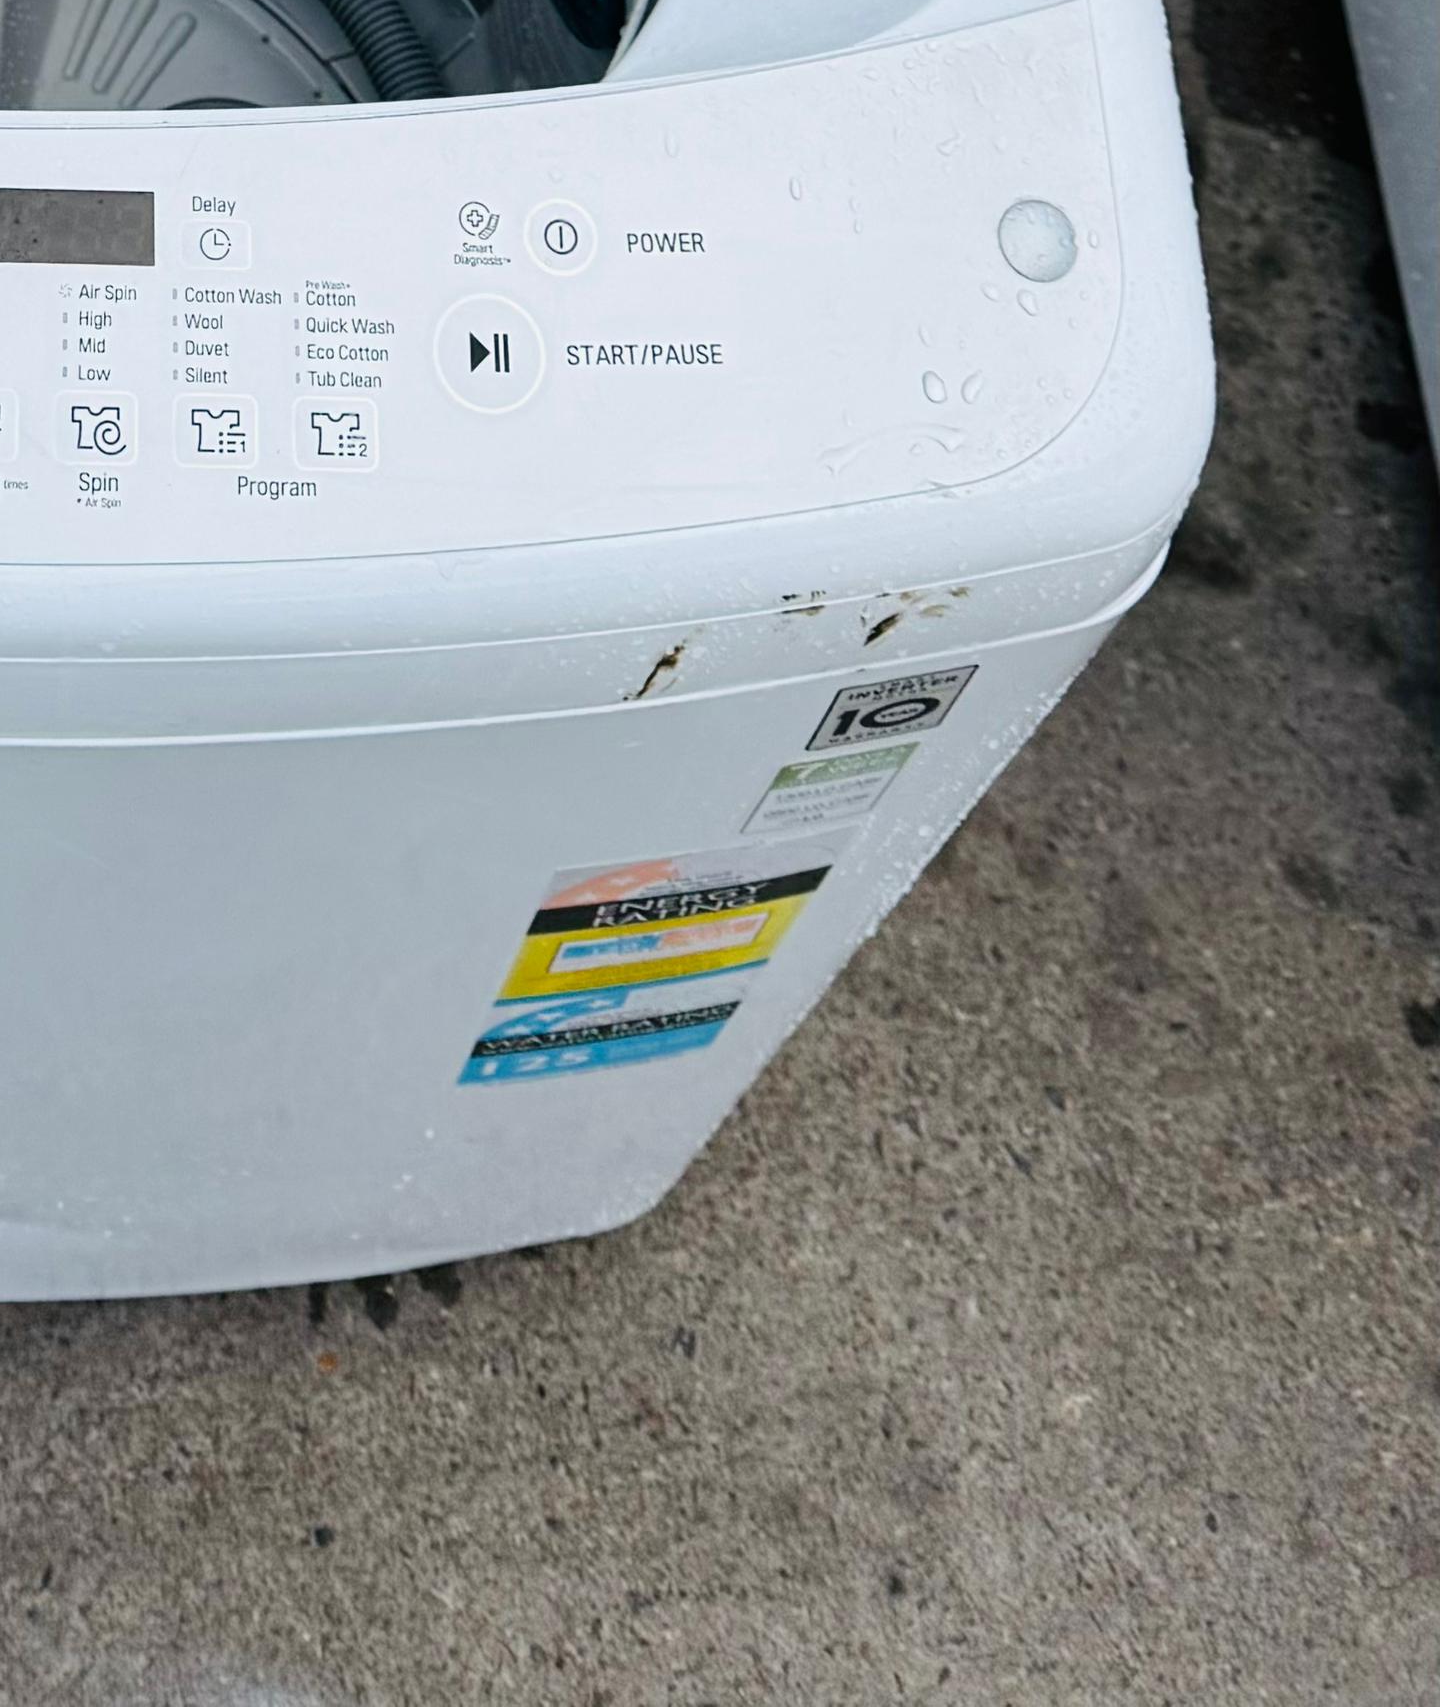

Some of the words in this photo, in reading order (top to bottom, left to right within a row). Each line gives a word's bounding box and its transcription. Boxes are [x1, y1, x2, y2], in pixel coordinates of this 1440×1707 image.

[191, 195, 236, 217] Delay
[626, 232, 706, 254] POWER
[78, 284, 101, 300] Air
[104, 285, 137, 303] Spin
[184, 287, 235, 304] Cotton
[238, 288, 282, 305] Wash
[305, 291, 356, 307] Cotton
[78, 311, 112, 330] High
[184, 313, 224, 330] Wool
[306, 317, 349, 334] Quick
[352, 318, 395, 335] Wash
[78, 338, 106, 354] Mid
[185, 340, 230, 357] Duvet
[307, 344, 335, 360] Eco
[338, 344, 389, 362] Cotton
[566, 343, 724, 366] START/PAUSE
[78, 365, 112, 381] Low
[185, 367, 228, 384] Silent
[308, 370, 336, 388] Tub
[339, 371, 382, 388] Clean
[78, 472, 119, 495] Spin
[237, 475, 317, 500] Program
[596, 882, 769, 917] ENERGY
